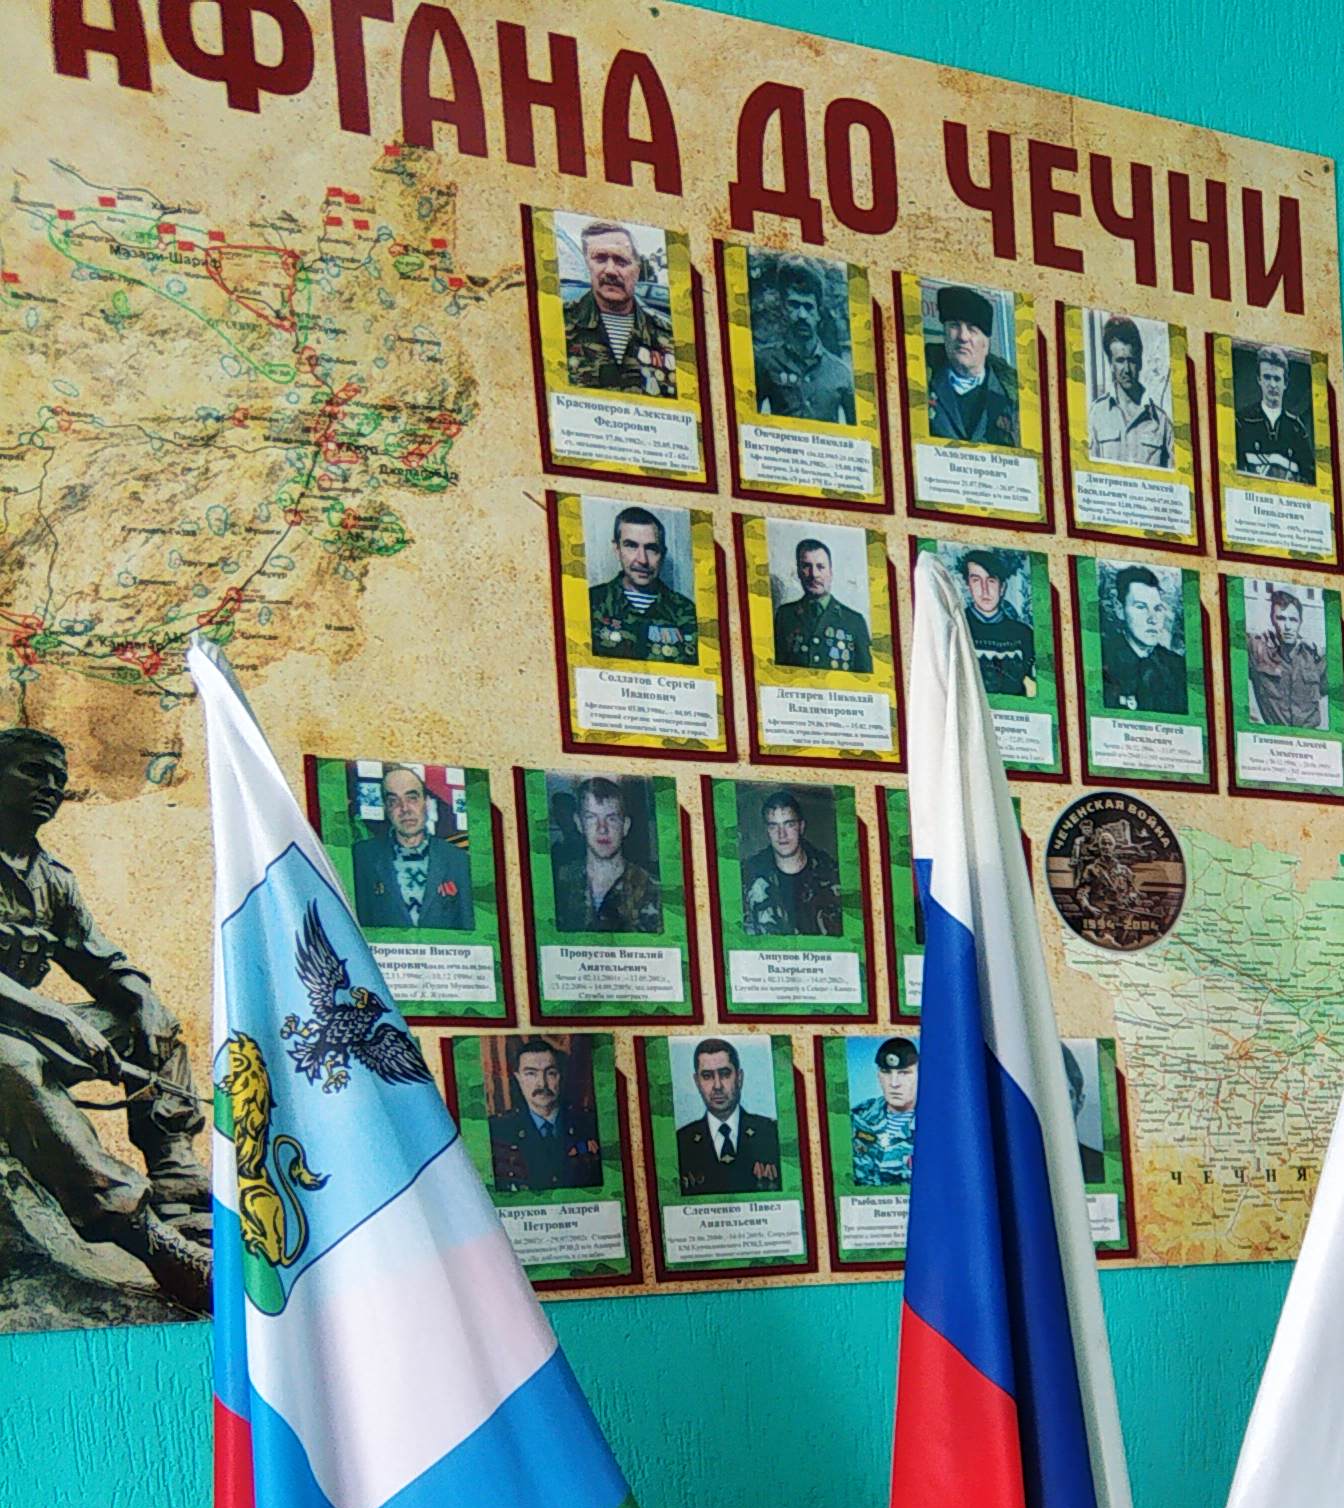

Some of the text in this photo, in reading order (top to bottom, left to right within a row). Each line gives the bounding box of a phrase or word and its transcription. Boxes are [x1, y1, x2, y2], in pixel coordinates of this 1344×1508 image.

[53, 0, 1304, 316] АФГАНА ДО ЧЕЧНИ
[109, 244, 221, 270] Мазари-Шариф
[594, 415, 657, 433] Федорович
[634, 407, 692, 427] Александр
[744, 440, 805, 455] Викторович
[812, 435, 854, 449] Николай
[991, 454, 1019, 467] Юрий
[949, 462, 1007, 479] Викторович
[1077, 484, 1128, 499] Васильевич
[1141, 482, 1174, 494] Алексей
[598, 671, 696, 691] Солдатов Сергей
[621, 687, 677, 702] Иванович
[777, 688, 874, 704] Дегтярев Николай
[788, 702, 865, 717] Владимирович
[1155, 724, 1185, 736] Сергей
[1124, 732, 1173, 745] Васильевич
[1053, 799, 1171, 850] ЧЕЧЕНСКАЯ ВОЙНА
[430, 946, 472, 959] Виктор
[559, 948, 664, 960] Пропустов Виталий
[578, 962, 649, 972] Анатольевич
[767, 964, 825, 976] Валерьевич
[1170, 1165, 1309, 1186] ЧЕЧНЯ
[559, 1204, 601, 1216] Андрей
[749, 1202, 782, 1213] Павел
[873, 1209, 909, 1219] Виктор
[523, 1220, 579, 1232] Петрович
[699, 1217, 769, 1229] Анатольевич
